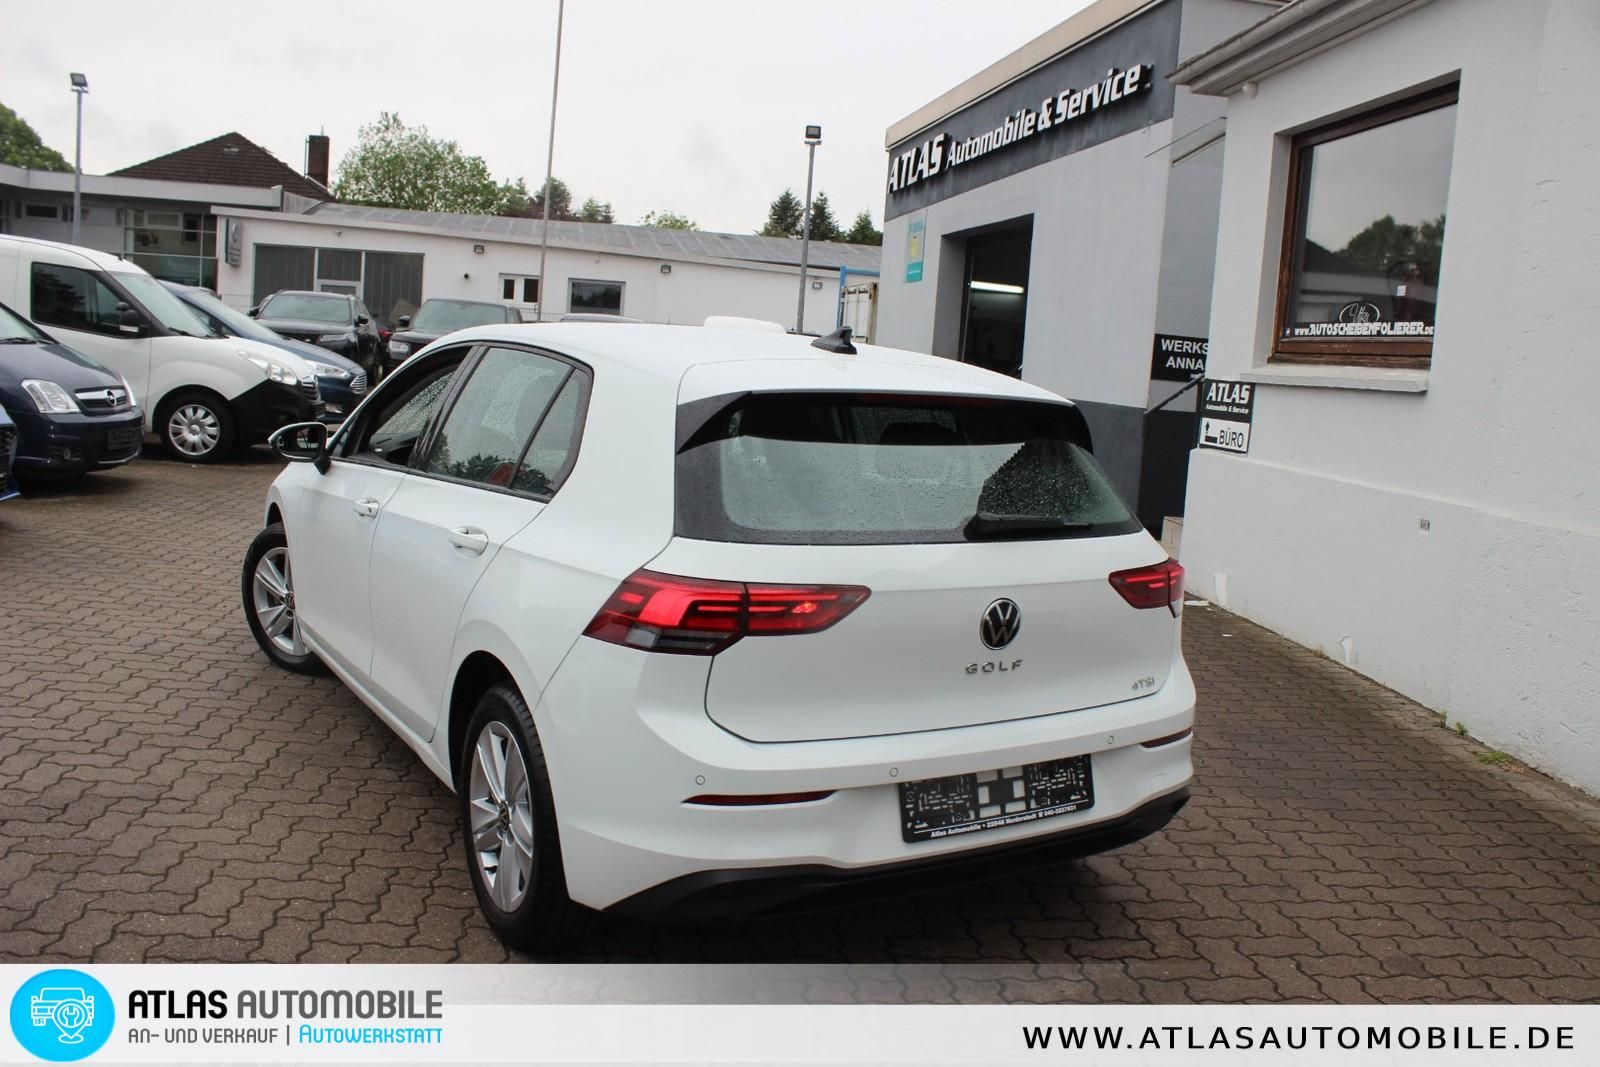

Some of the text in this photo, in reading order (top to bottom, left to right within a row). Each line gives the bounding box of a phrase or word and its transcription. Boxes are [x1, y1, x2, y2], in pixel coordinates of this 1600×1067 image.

[887, 64, 1141, 194] ATLAS Automobile & Service
[1161, 339, 1209, 355] WERKS
[1166, 356, 1204, 371] ANNA
[1206, 382, 1251, 404] ATLAS
[1218, 427, 1244, 448] BÜRO
[965, 659, 1023, 674] GOLF
[930, 829, 947, 838] Atlas
[948, 823, 982, 836] Automobile
